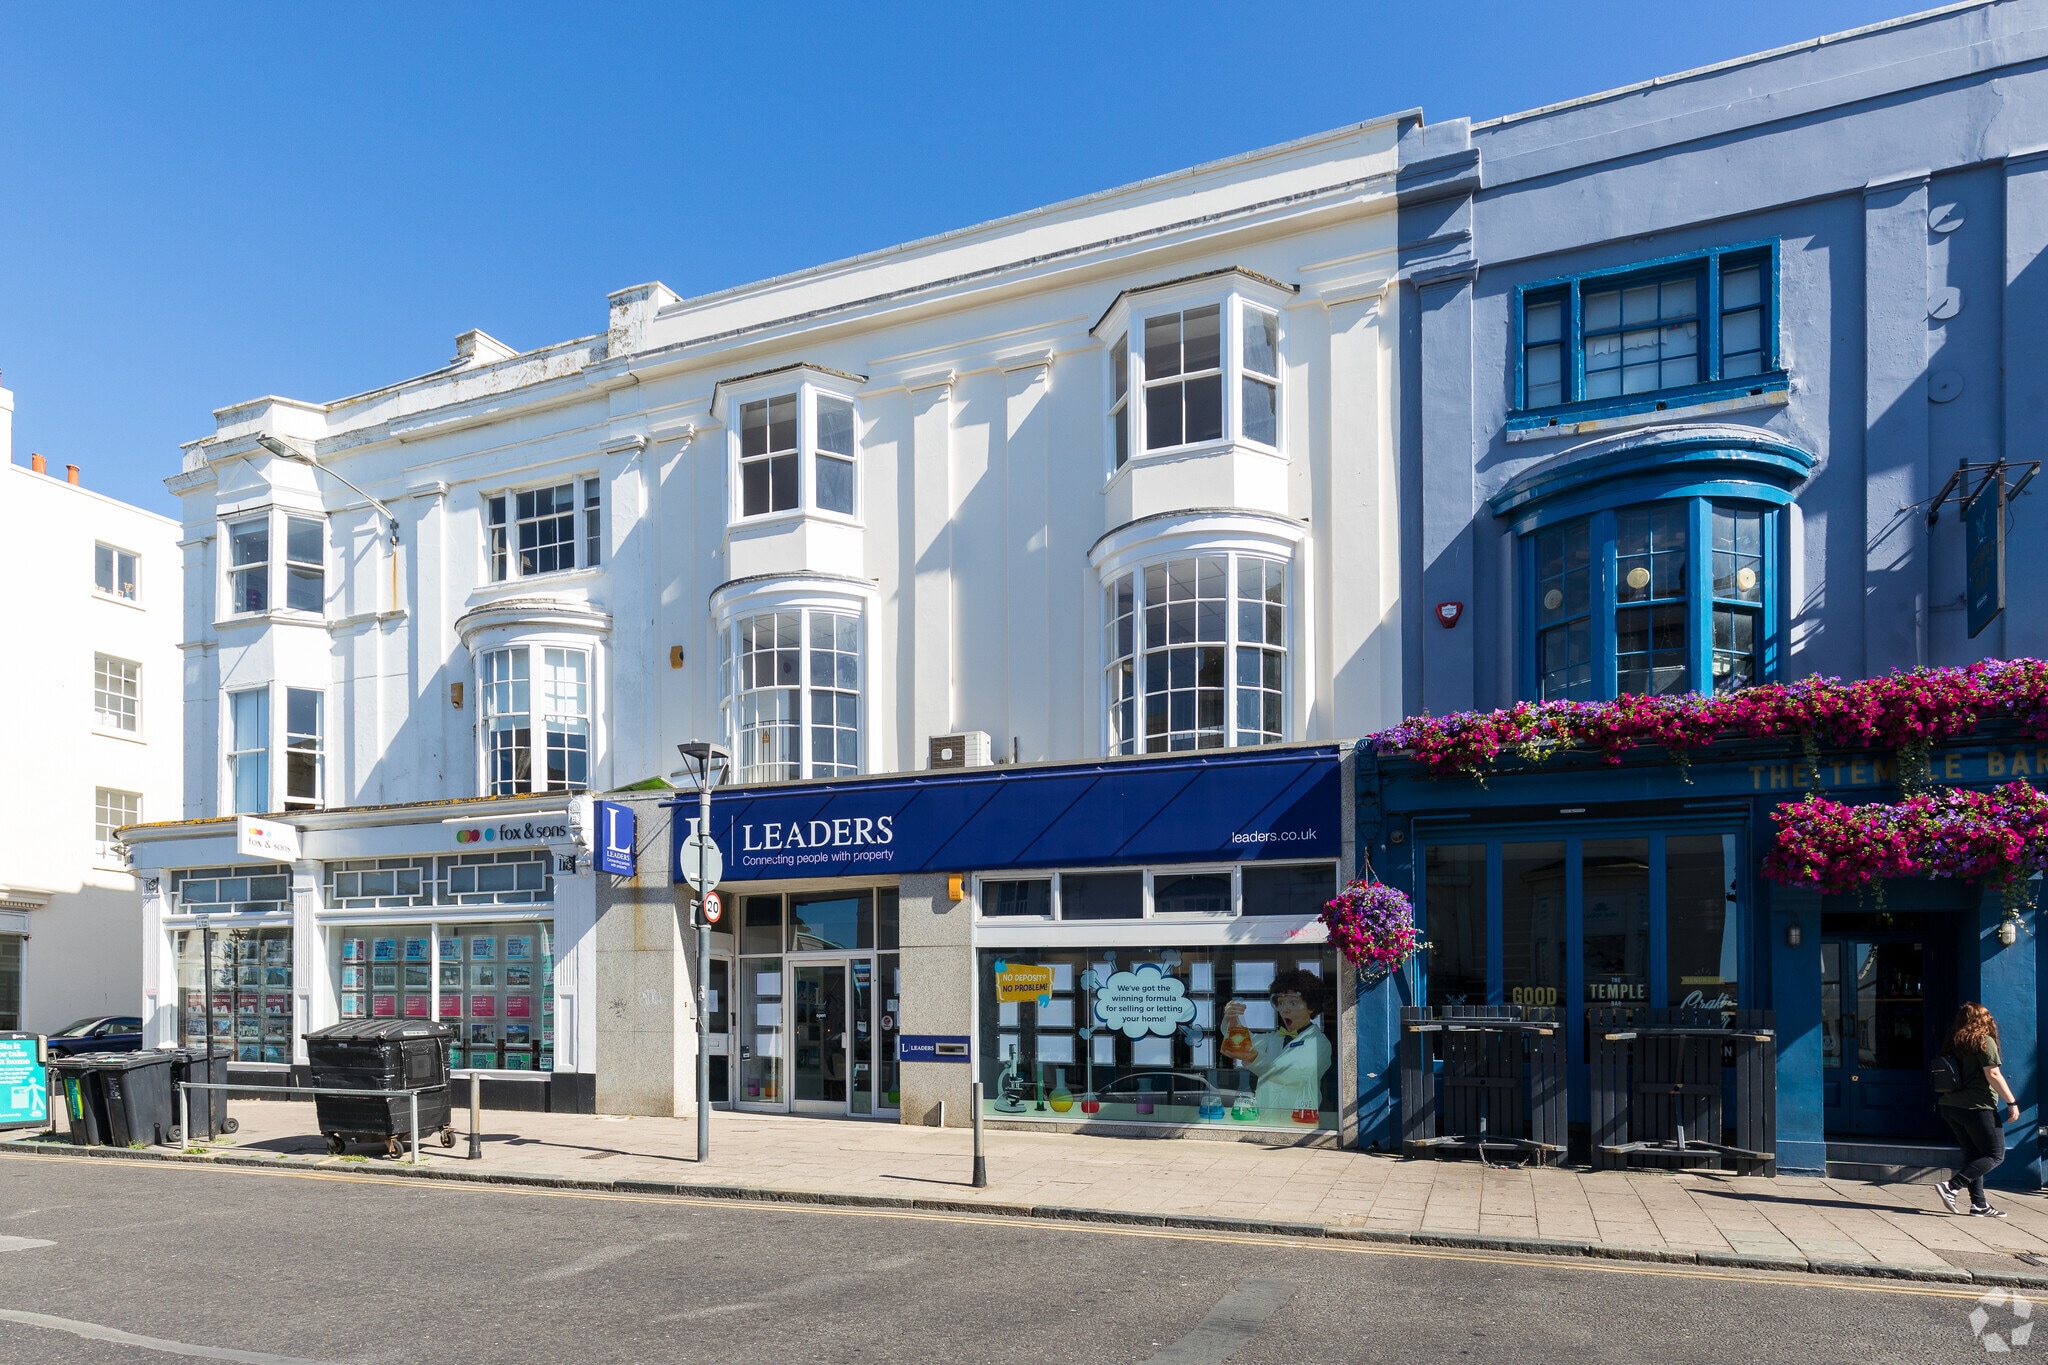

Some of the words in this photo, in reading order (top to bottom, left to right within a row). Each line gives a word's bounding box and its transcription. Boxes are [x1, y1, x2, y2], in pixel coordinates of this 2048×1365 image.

[1749, 764, 1810, 789] THE
[1829, 754, 1963, 786] TEMLE
[499, 824, 522, 841] fox
[523, 822, 535, 840] &
[536, 825, 567, 838] sons
[607, 807, 632, 854] L
[742, 816, 894, 851] LEADERS
[1232, 828, 1317, 843] leaders.co.uk
[248, 837, 262, 847] fox
[264, 840, 271, 849] &
[273, 844, 291, 852] sons
[606, 851, 631, 862] LEADERS
[742, 854, 794, 868] Connecting
[796, 852, 829, 865] people
[831, 851, 851, 862] with
[853, 849, 894, 863] property
[707, 900, 719, 913] 20
[1002, 973, 1013, 982] NO
[1015, 973, 1047, 982] DEPOSIT?
[1002, 984, 1013, 992] NO
[1014, 983, 1048, 992] PROBLEM!
[1141, 985, 1155, 993] got
[1590, 984, 1645, 1000] TEMPLE
[1512, 987, 1557, 1005] GOOD
[1118, 1005, 1144, 1014] selling
[1156, 1005, 1183, 1014] letting
[1122, 1015, 1139, 1023] your
[1141, 1015, 1167, 1023] home!
[901, 1043, 909, 1053] L
[1298, 1100, 1312, 1108] LOVE
